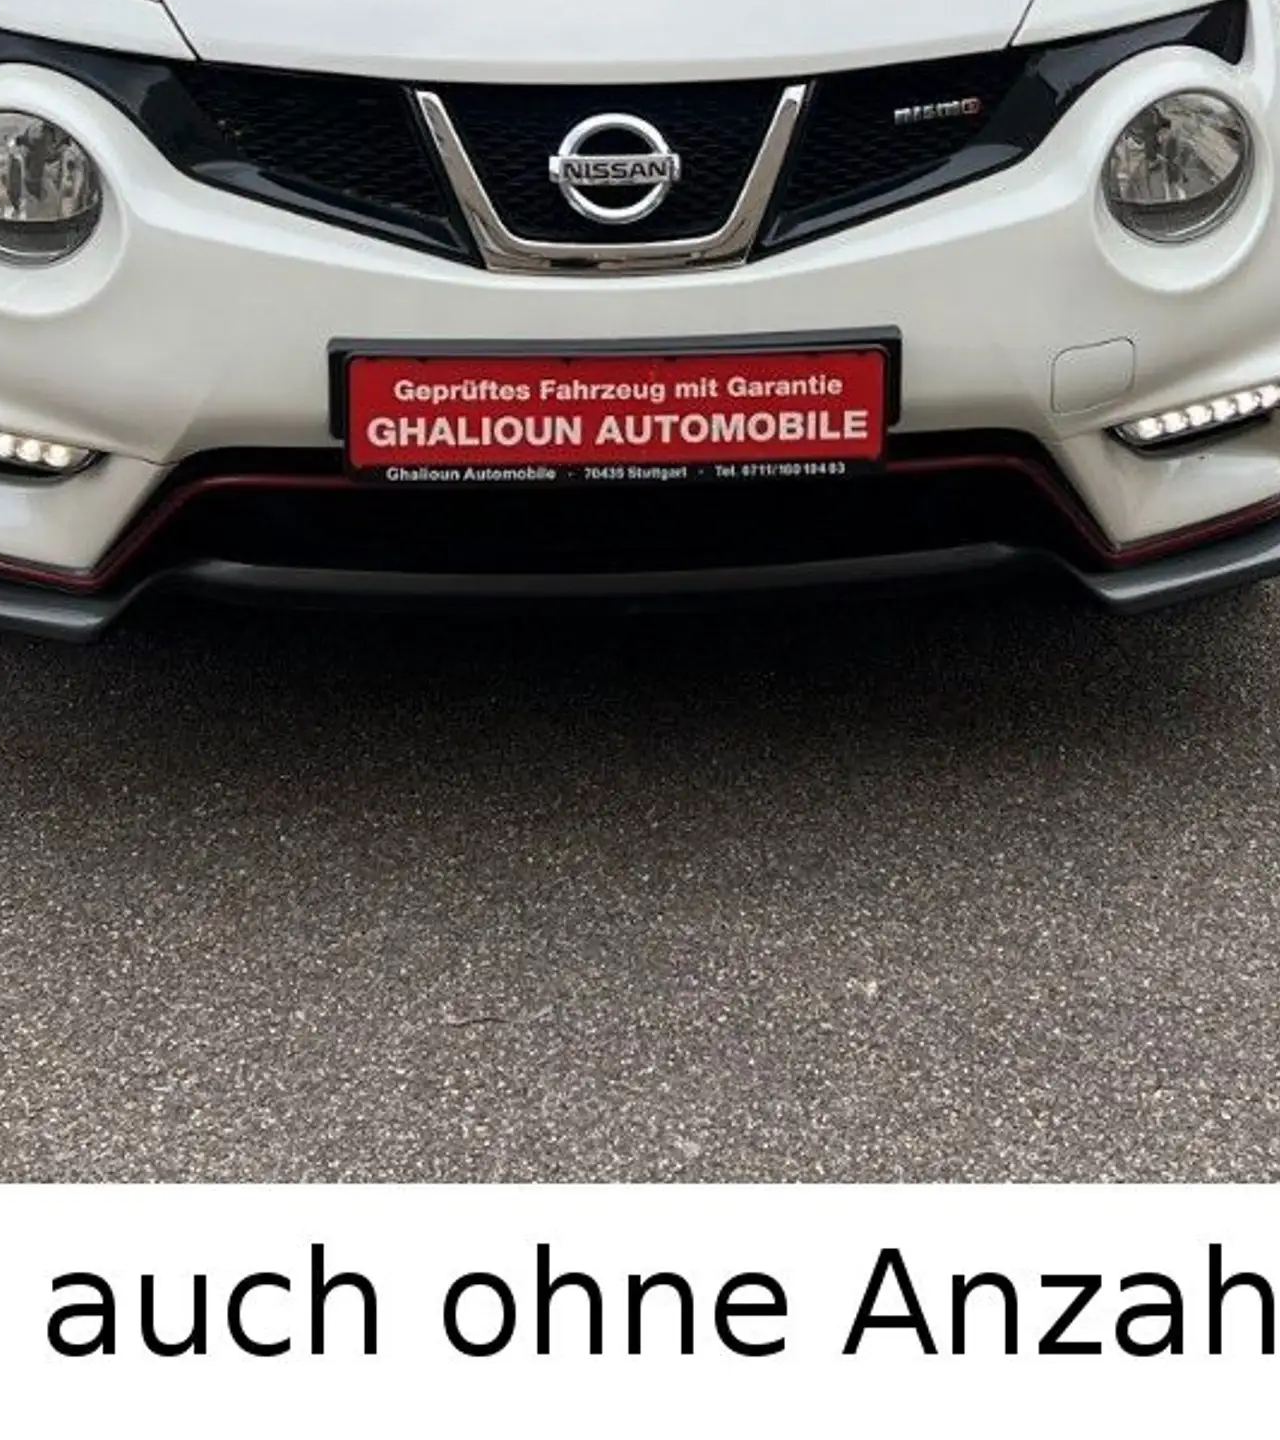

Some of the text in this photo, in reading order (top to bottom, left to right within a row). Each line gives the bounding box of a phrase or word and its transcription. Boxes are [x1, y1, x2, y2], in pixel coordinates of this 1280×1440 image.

[563, 160, 667, 180] NISSAN
[394, 374, 844, 404] Geprüftes Fahrzeug mit Garantie
[366, 410, 869, 447] GHALIOUN AUTOMOBILE
[386, 466, 460, 481] Ghalioun
[462, 466, 557, 481] Automobile
[627, 465, 687, 481] Stuttgart
